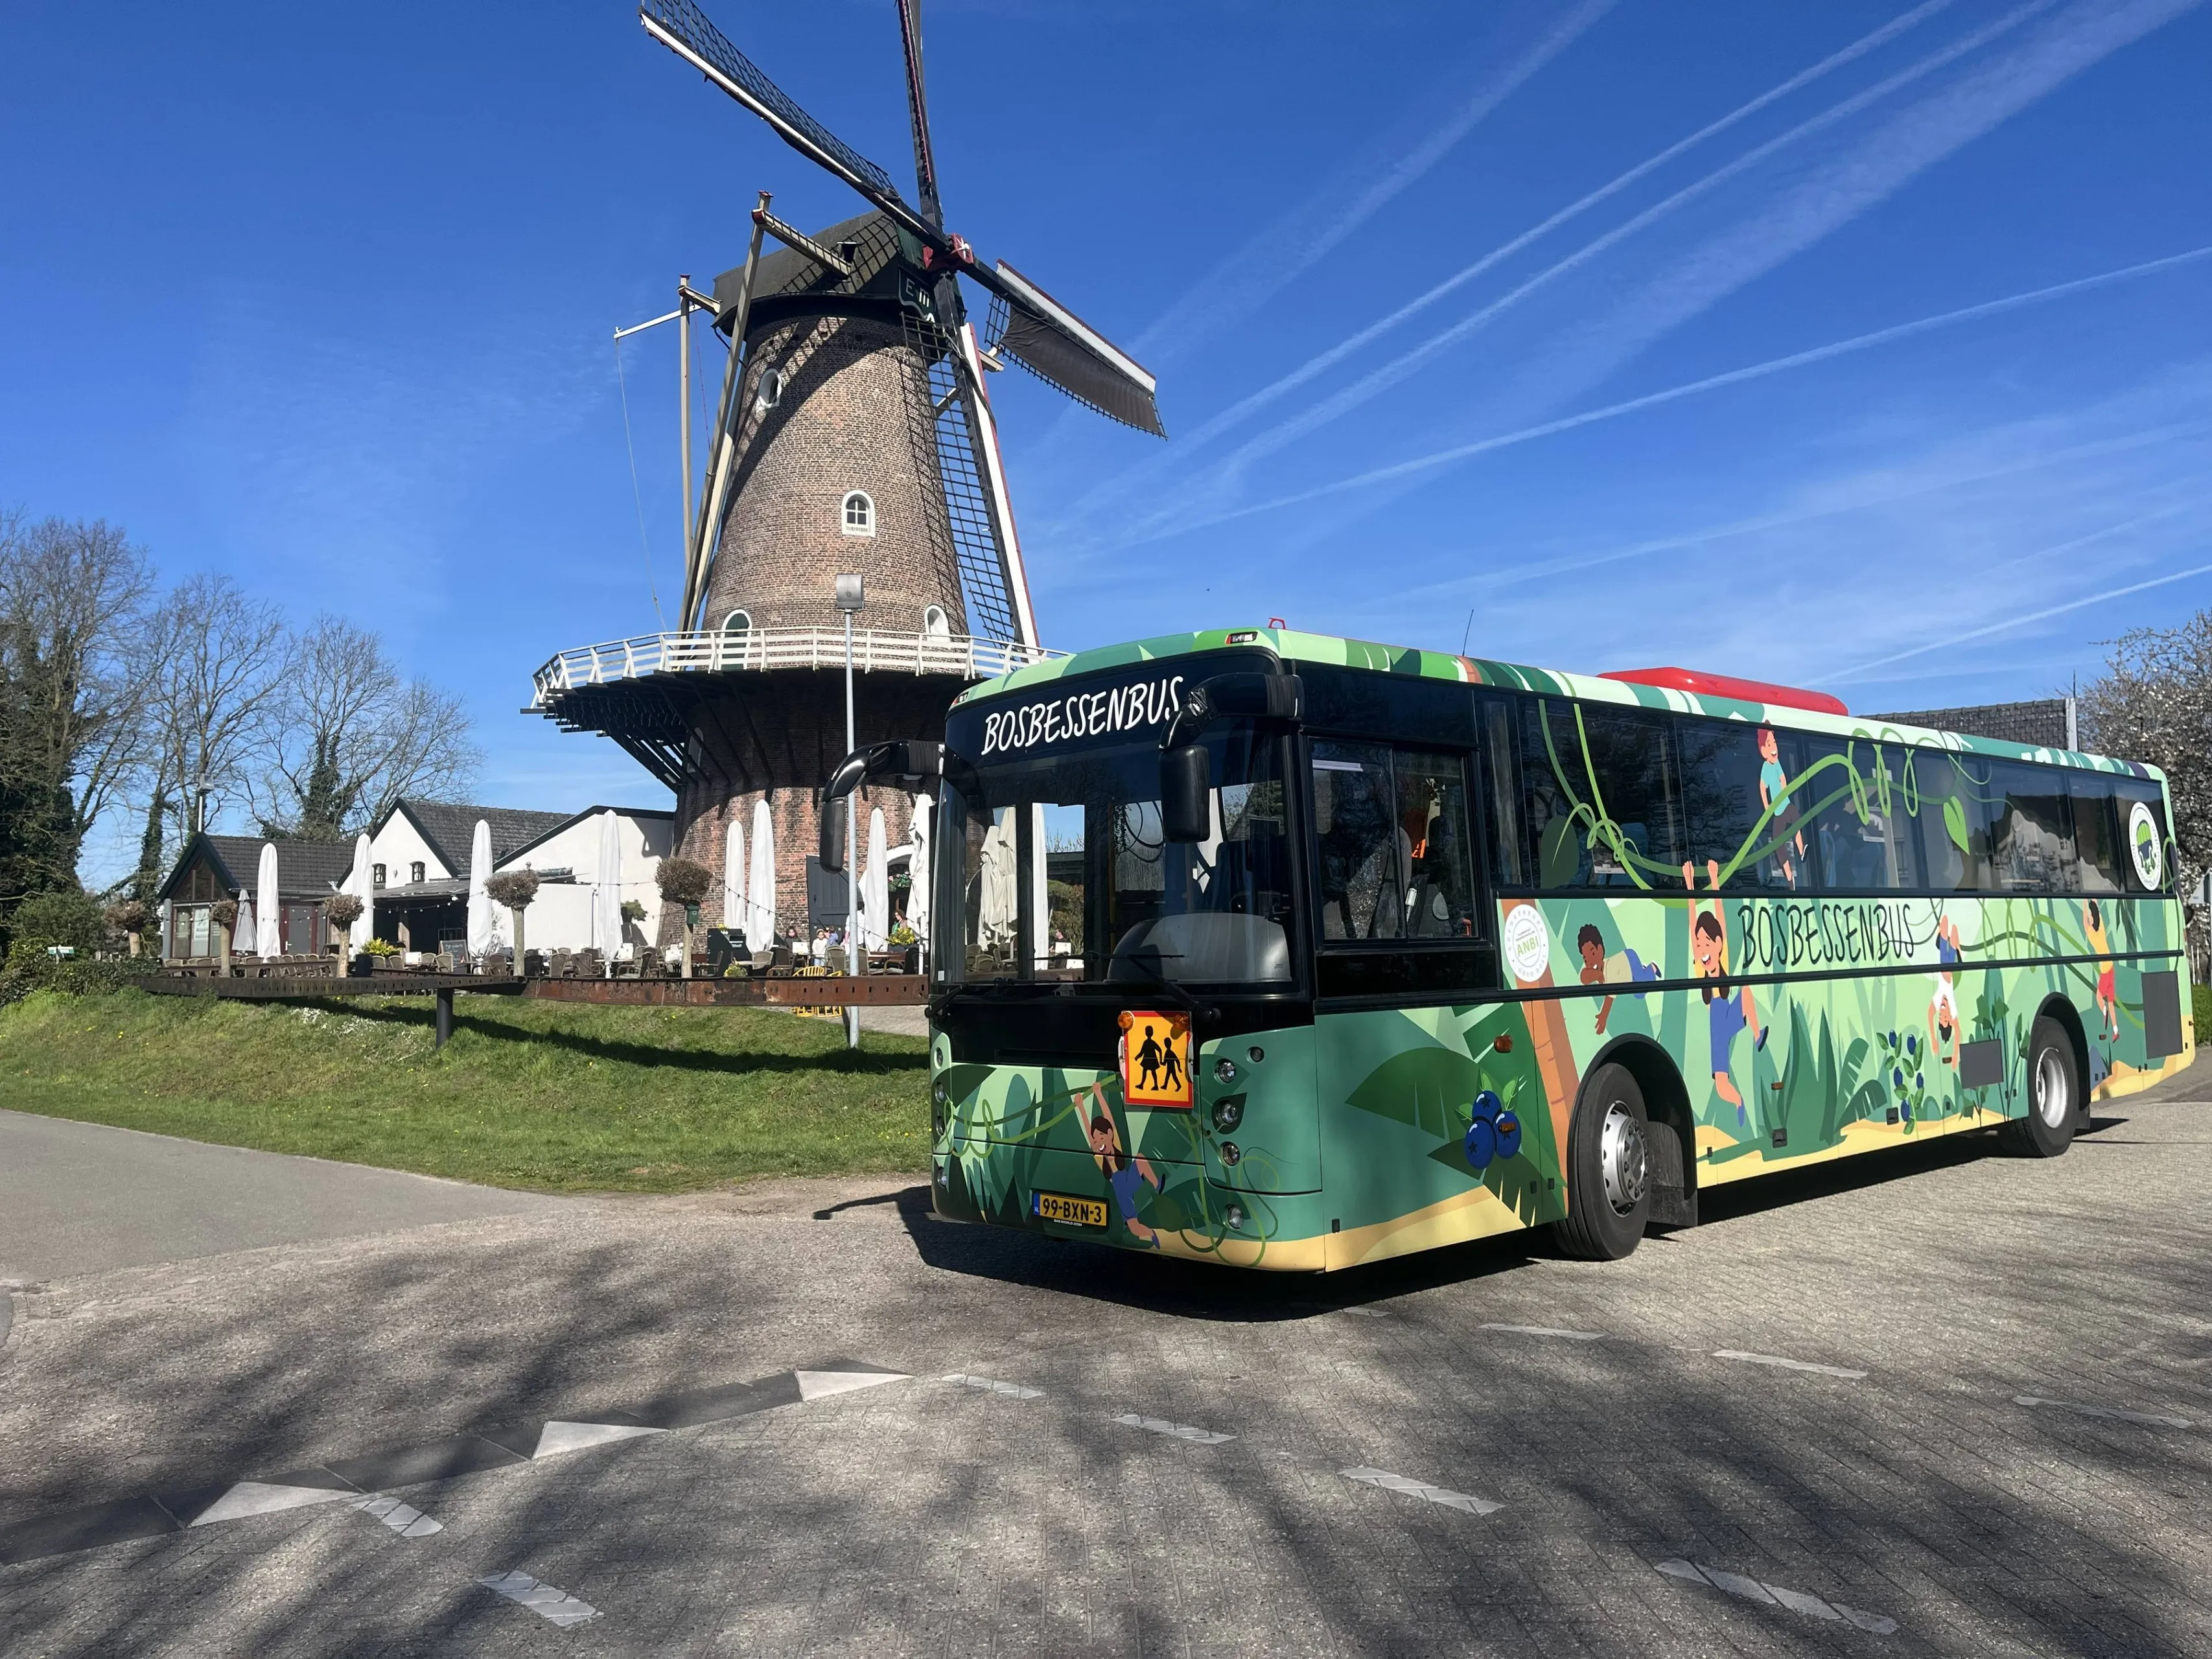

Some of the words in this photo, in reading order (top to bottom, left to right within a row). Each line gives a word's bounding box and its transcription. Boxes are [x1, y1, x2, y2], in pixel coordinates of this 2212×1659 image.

[981, 675, 1183, 756] BOSBESSENBUS
[1517, 935, 1539, 957] ANBI
[1738, 904, 1914, 969] BOSBESSENBUS
[1043, 1198, 1102, 1224] 99-BXN-3
